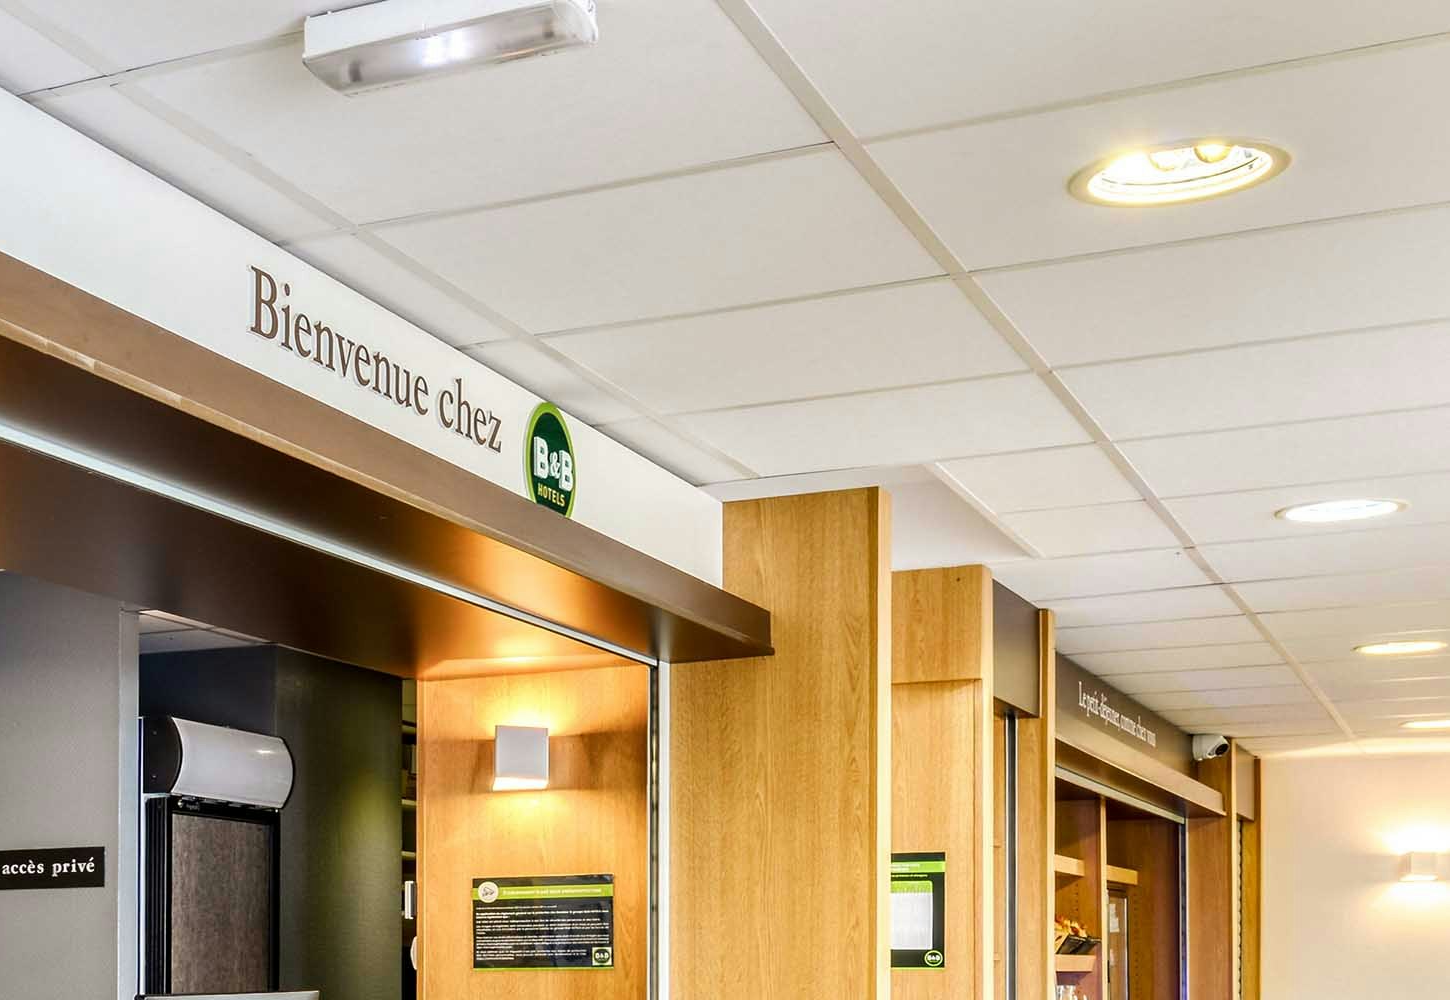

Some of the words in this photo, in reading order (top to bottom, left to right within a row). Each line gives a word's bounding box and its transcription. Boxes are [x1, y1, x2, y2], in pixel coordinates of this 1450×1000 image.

[250, 264, 429, 416] Bienvenue
[439, 377, 503, 454] chez
[533, 435, 574, 492] B&B
[537, 481, 566, 508] HOTELS
[1, 859, 45, 876] accès
[51, 856, 95, 877] privé
